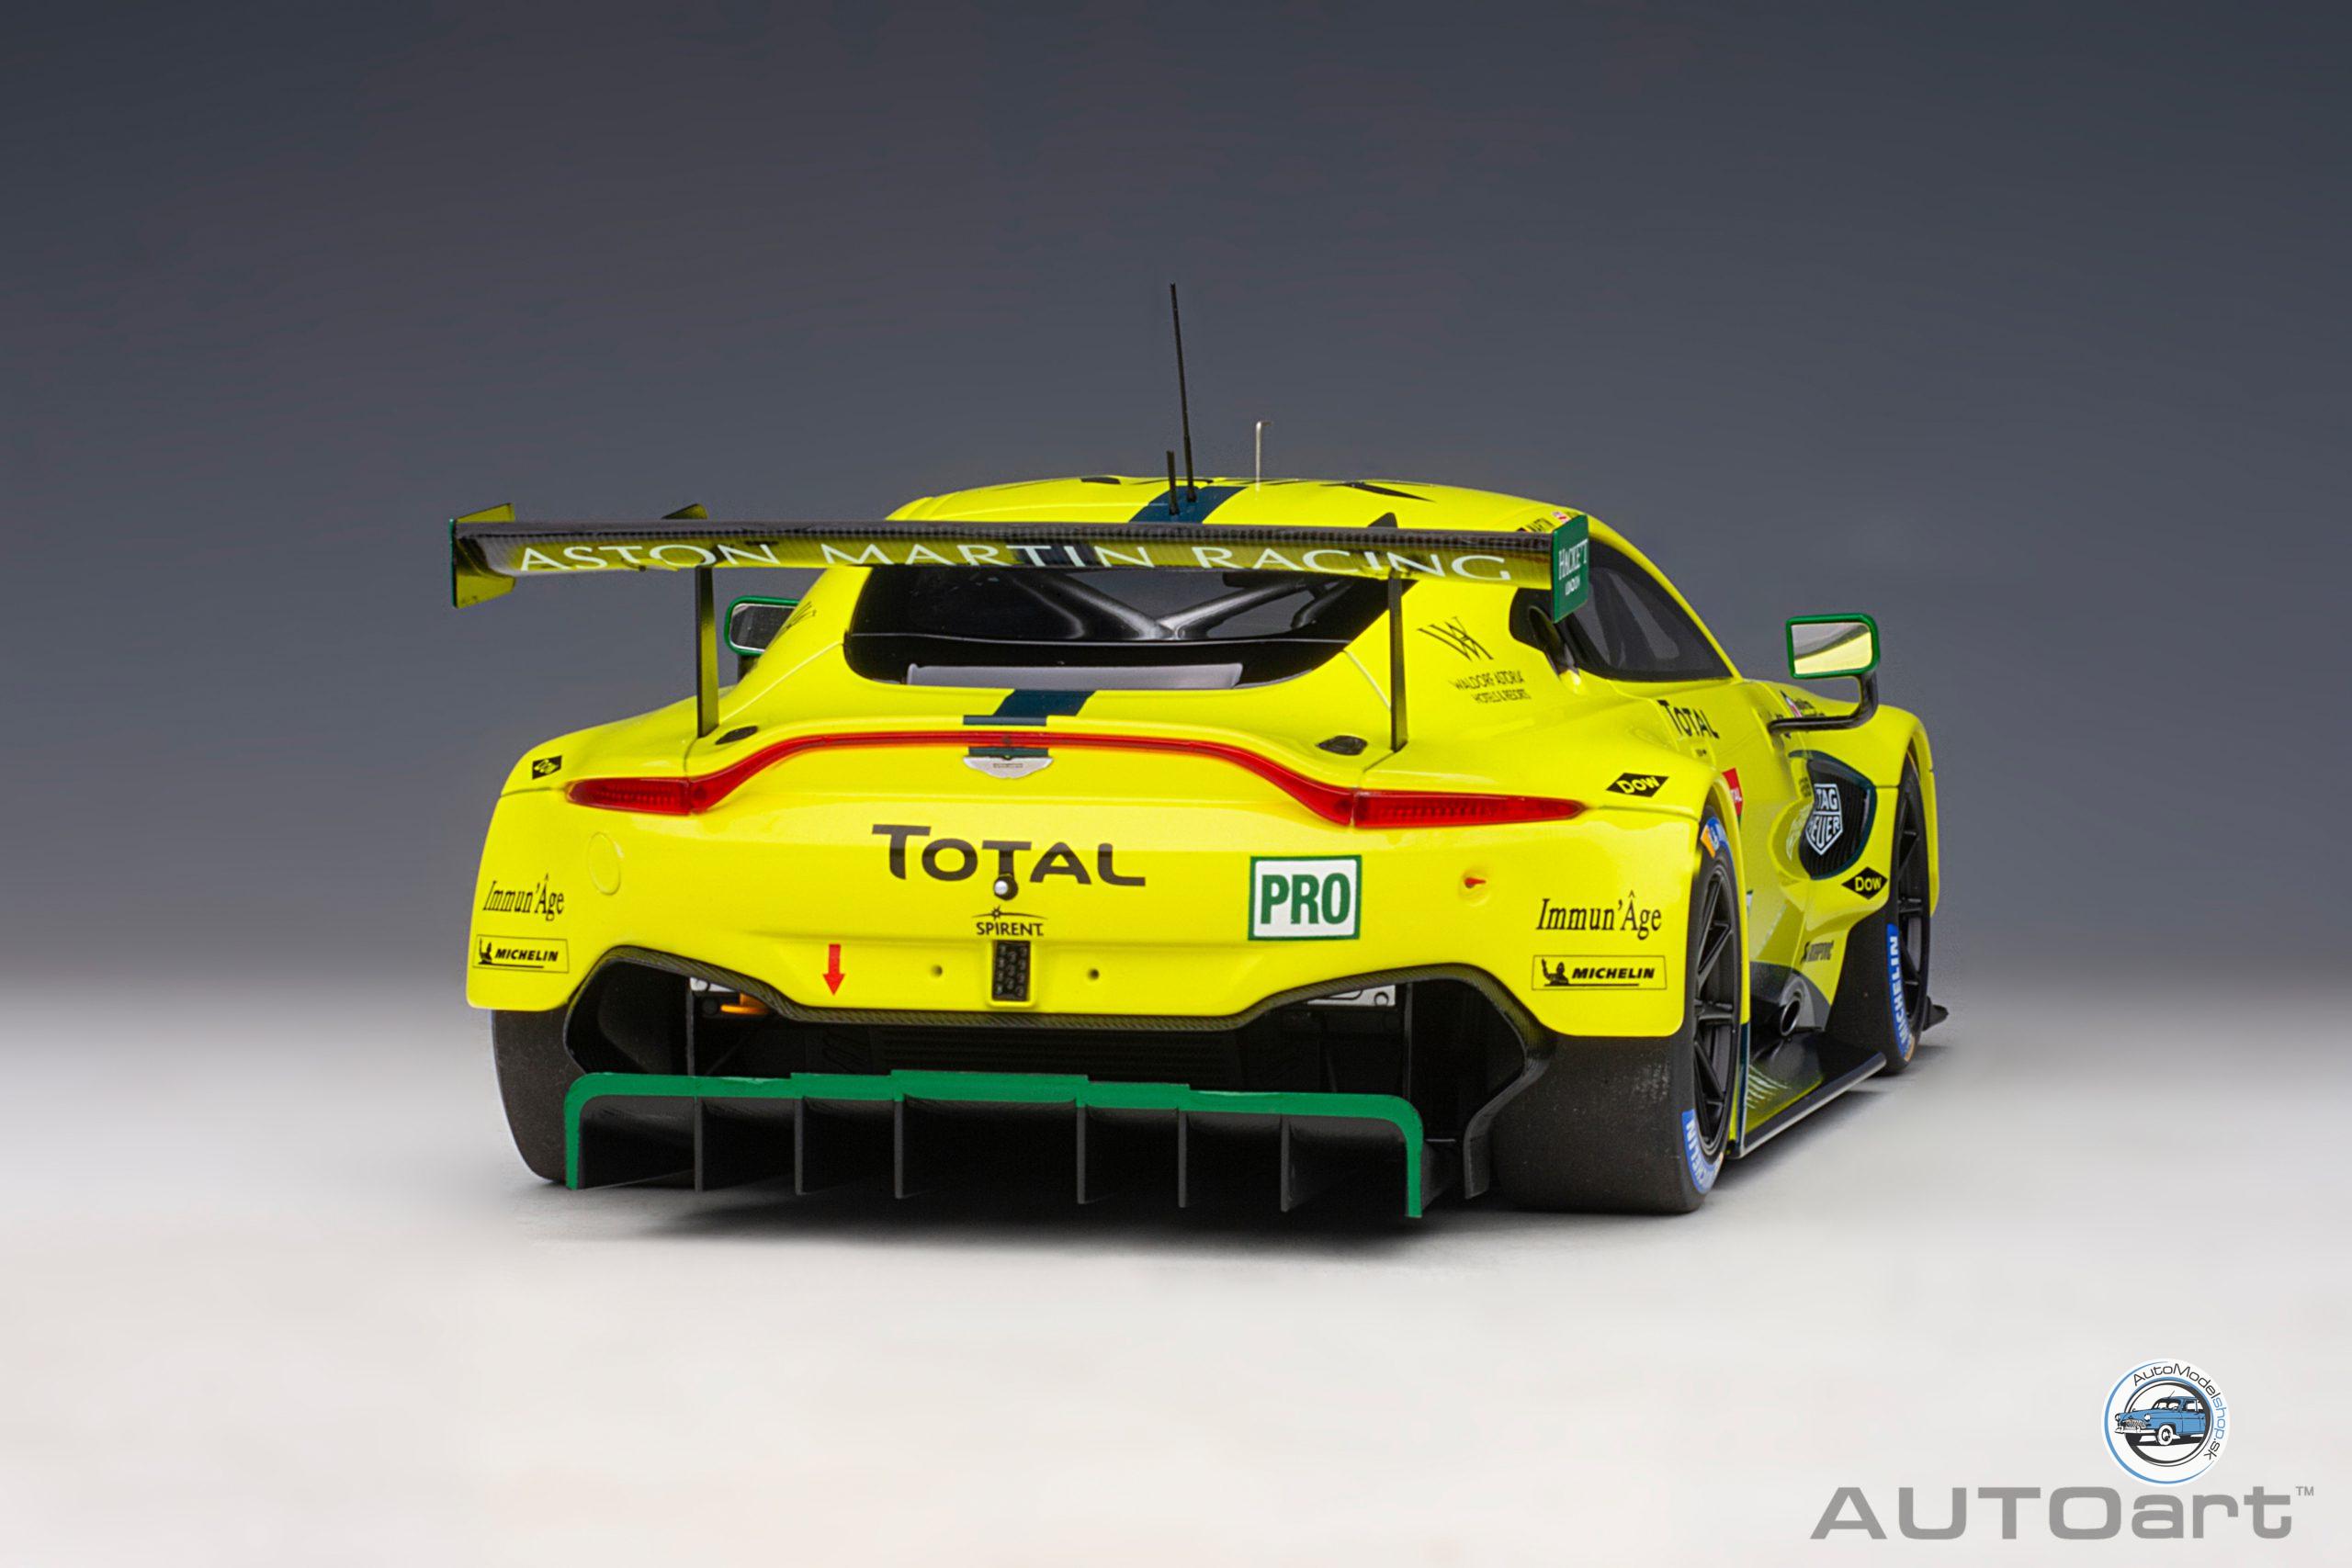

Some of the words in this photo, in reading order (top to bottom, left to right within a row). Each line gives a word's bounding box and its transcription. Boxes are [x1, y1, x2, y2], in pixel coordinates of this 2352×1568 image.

[520, 544, 782, 571] ASTON
[820, 544, 1154, 568] MARTIN
[1192, 547, 1510, 581] RACING
[1657, 699, 1720, 739] TOTAL
[1616, 776, 1661, 795] DOW
[1815, 788, 1838, 810] TAG
[872, 824, 1146, 886] TOTAL
[1854, 876, 1883, 892] DOW
[1261, 873, 1351, 925] PRO
[494, 947, 560, 963] MICHELIN
[1572, 966, 1656, 980] MICHELIN
